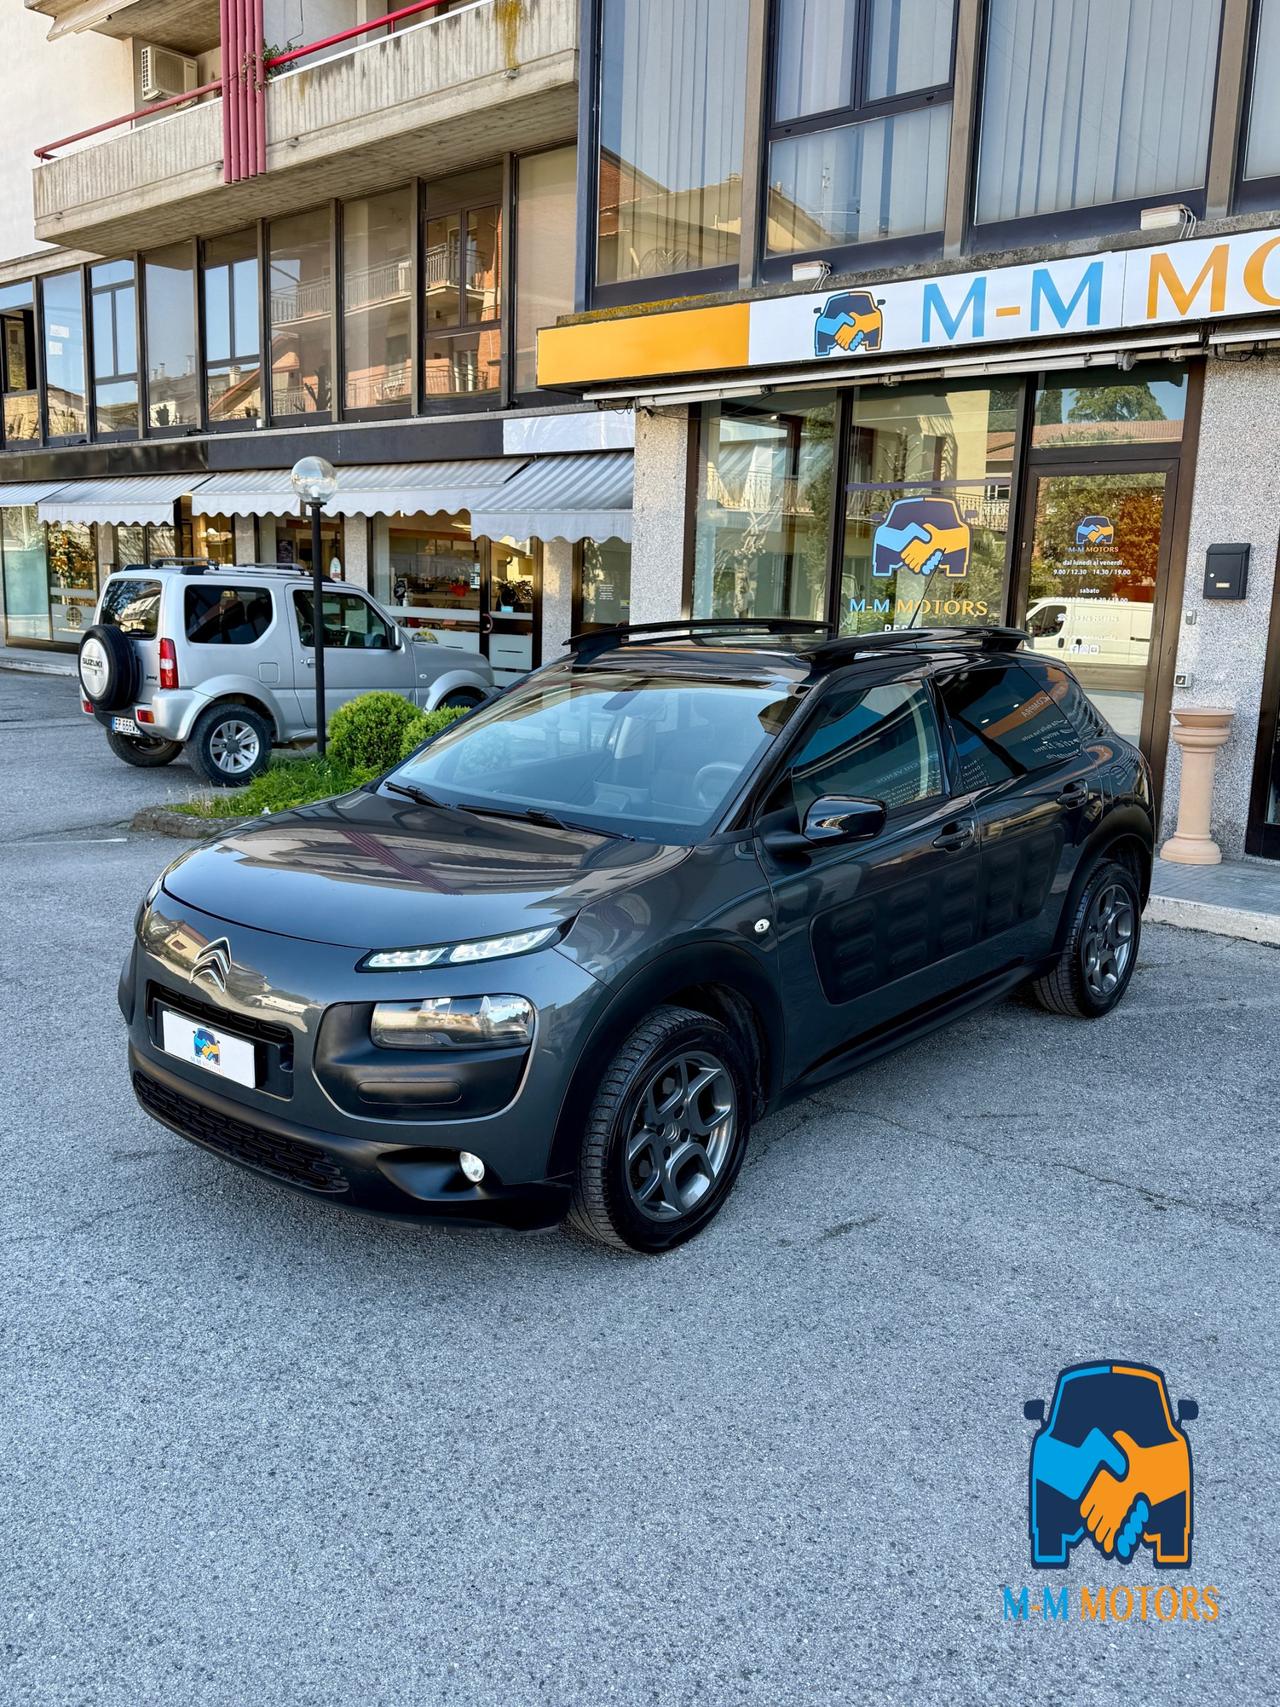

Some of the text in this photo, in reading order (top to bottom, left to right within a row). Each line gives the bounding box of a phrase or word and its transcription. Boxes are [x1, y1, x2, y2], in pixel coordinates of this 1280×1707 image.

[922, 261, 1104, 342] M-M
[849, 598, 988, 617] M-M MOTORS
[82, 657, 103, 668] SUZUKI
